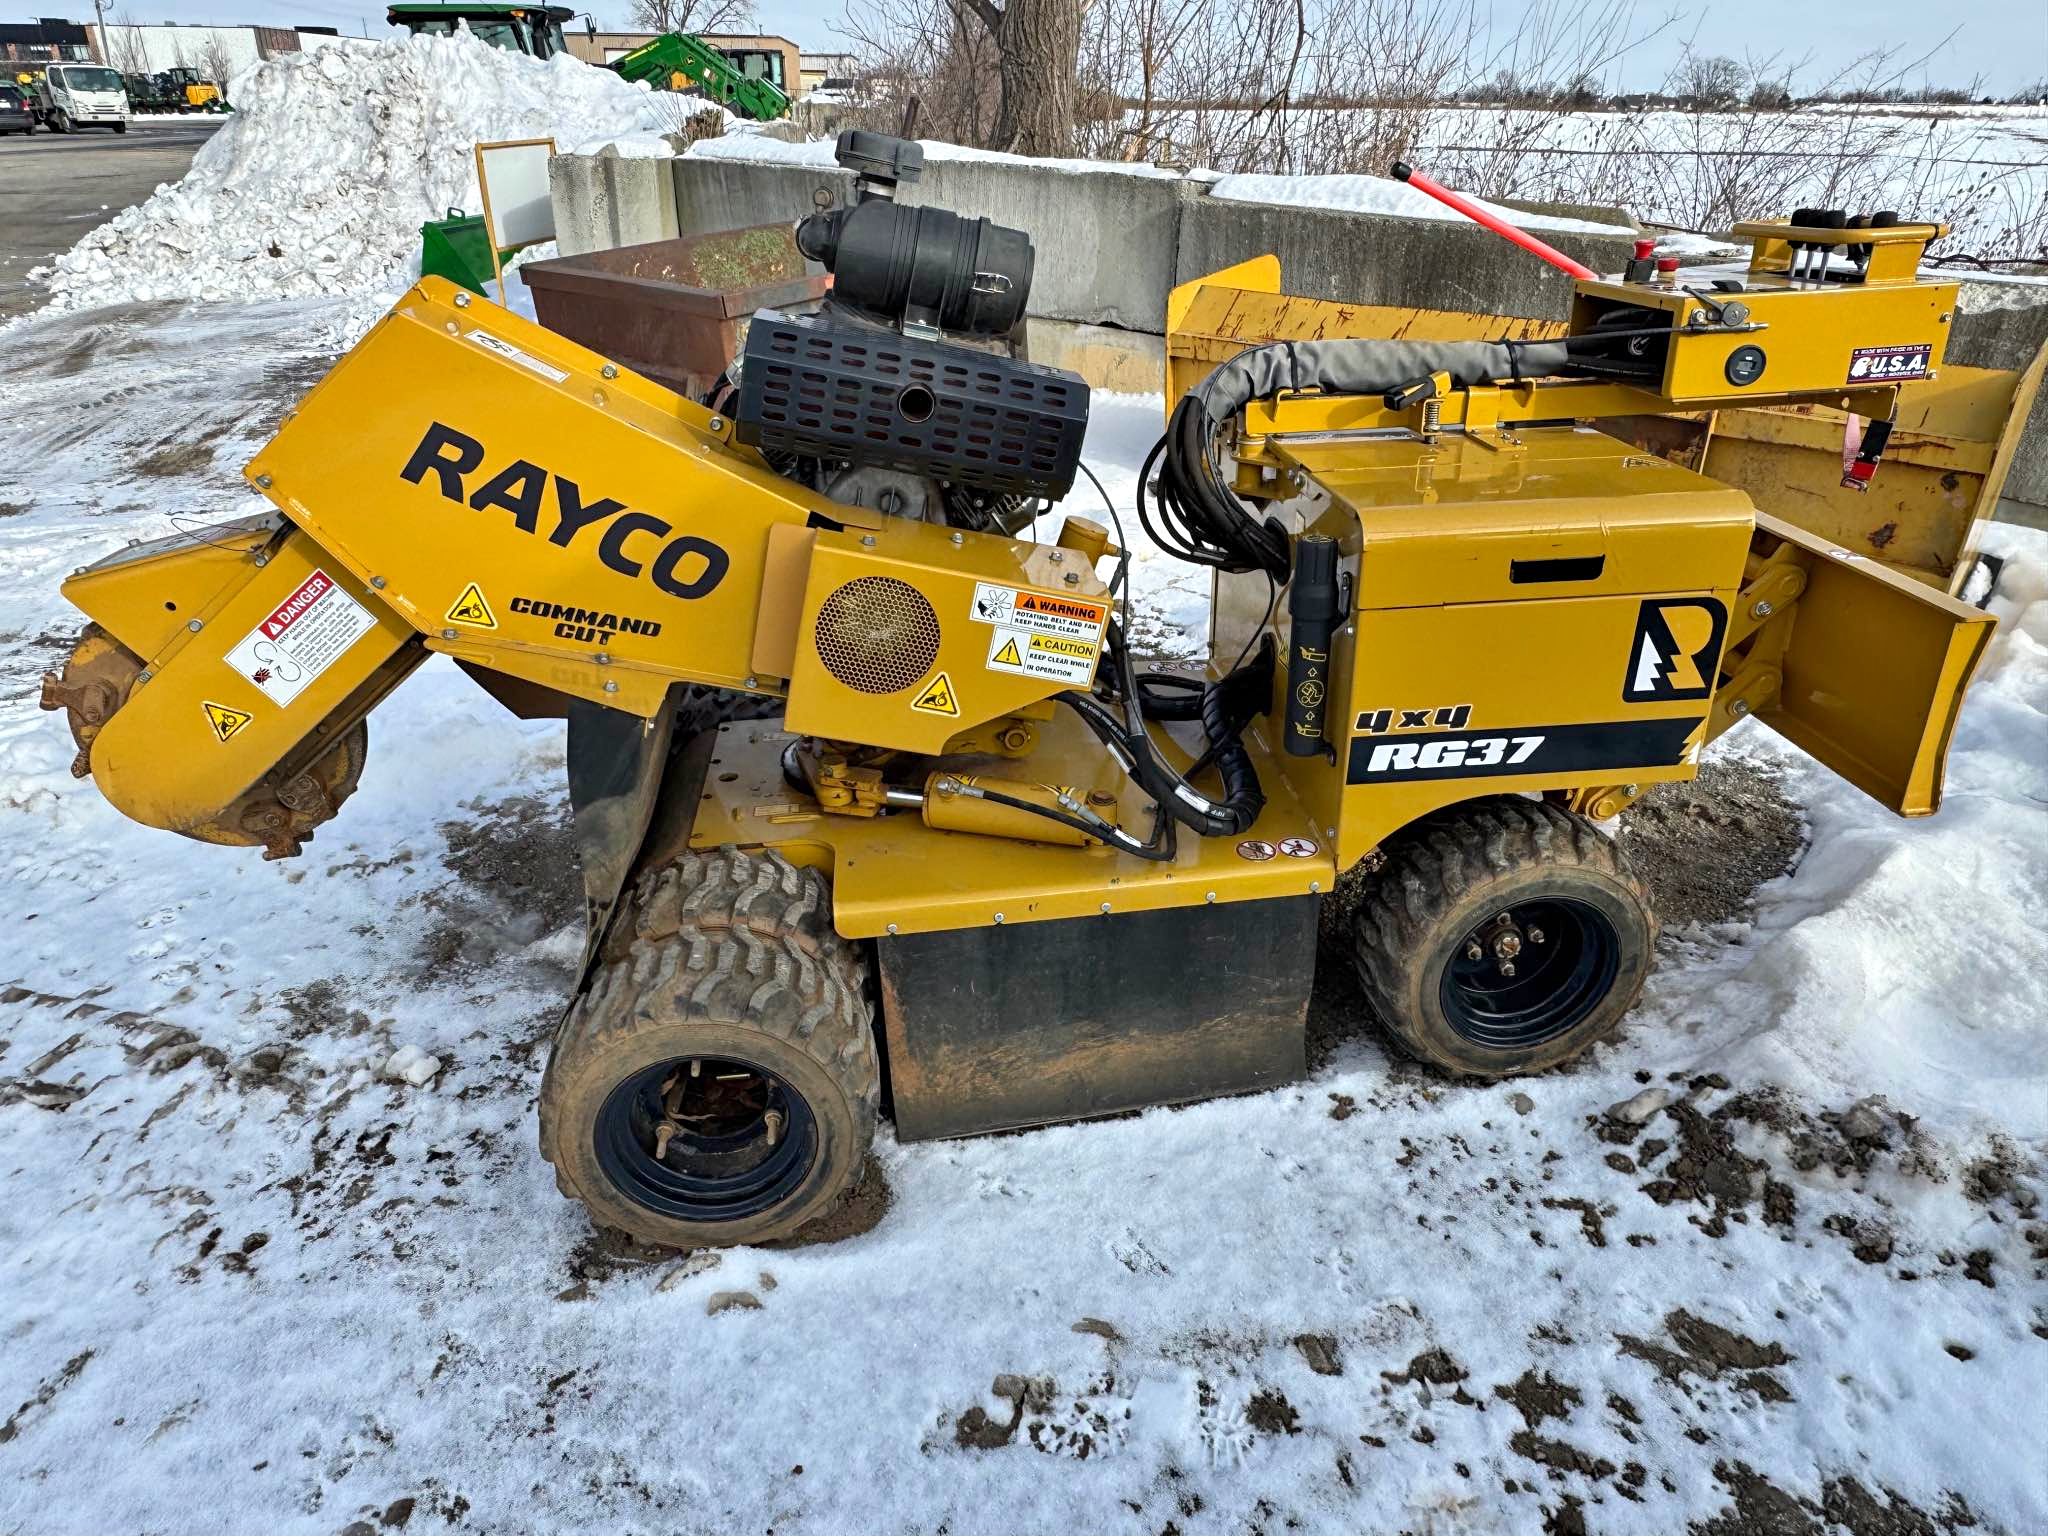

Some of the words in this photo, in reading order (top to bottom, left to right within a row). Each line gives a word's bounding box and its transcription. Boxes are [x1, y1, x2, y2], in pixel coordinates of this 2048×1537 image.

[1871, 354, 1926, 373] U.S.A.
[400, 421, 730, 600] RAYCO
[277, 578, 328, 624] DANGER
[1039, 601, 1096, 619] WARNING
[509, 597, 662, 637] COMMAND
[1016, 611, 1049, 621] ROTATING
[1051, 616, 1067, 625] BELT
[1068, 618, 1083, 627] AND
[1084, 622, 1097, 630] FAN
[554, 623, 617, 646] CUT
[1033, 621, 1057, 630] HANDS
[1058, 625, 1079, 634] CLEAR
[1044, 640, 1094, 656] CAUTION
[1029, 653, 1047, 661] KEEP
[1047, 656, 1069, 665] CLEAR
[1070, 660, 1091, 668] WHILE
[1035, 666, 1072, 677] OPERATION
[1354, 704, 1472, 734] 4x4
[1367, 736, 1546, 772] RG37
